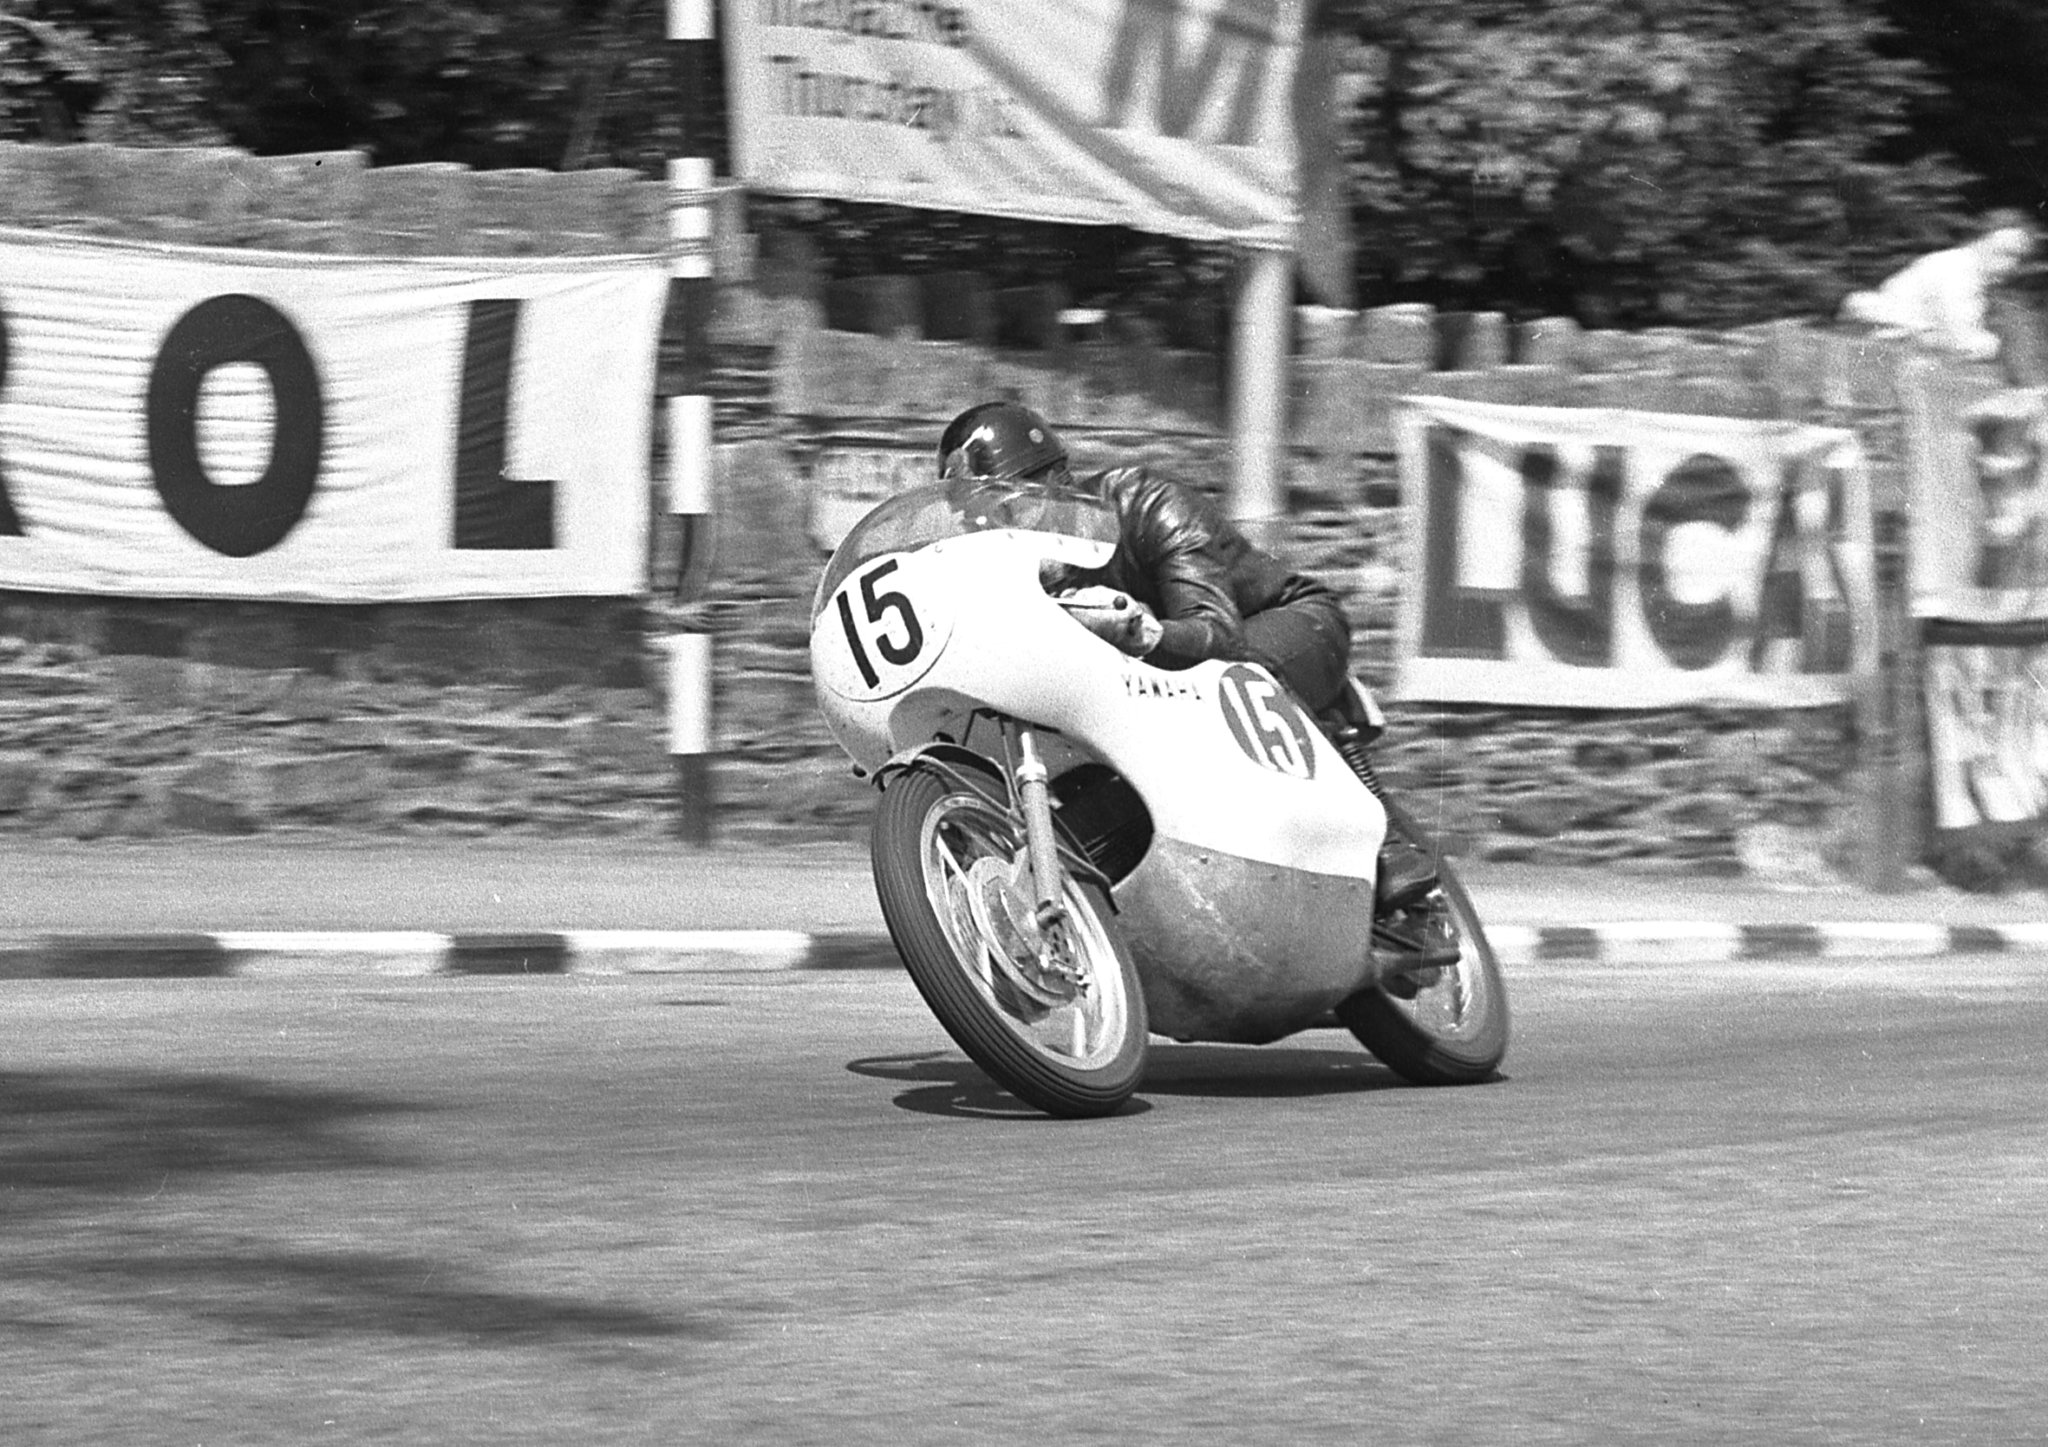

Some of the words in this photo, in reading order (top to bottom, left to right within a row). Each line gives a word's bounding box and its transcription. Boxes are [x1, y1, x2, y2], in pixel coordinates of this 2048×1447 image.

[0, 293, 557, 557] OL
[836, 558, 924, 689] 15
[1221, 676, 1310, 779] 15
